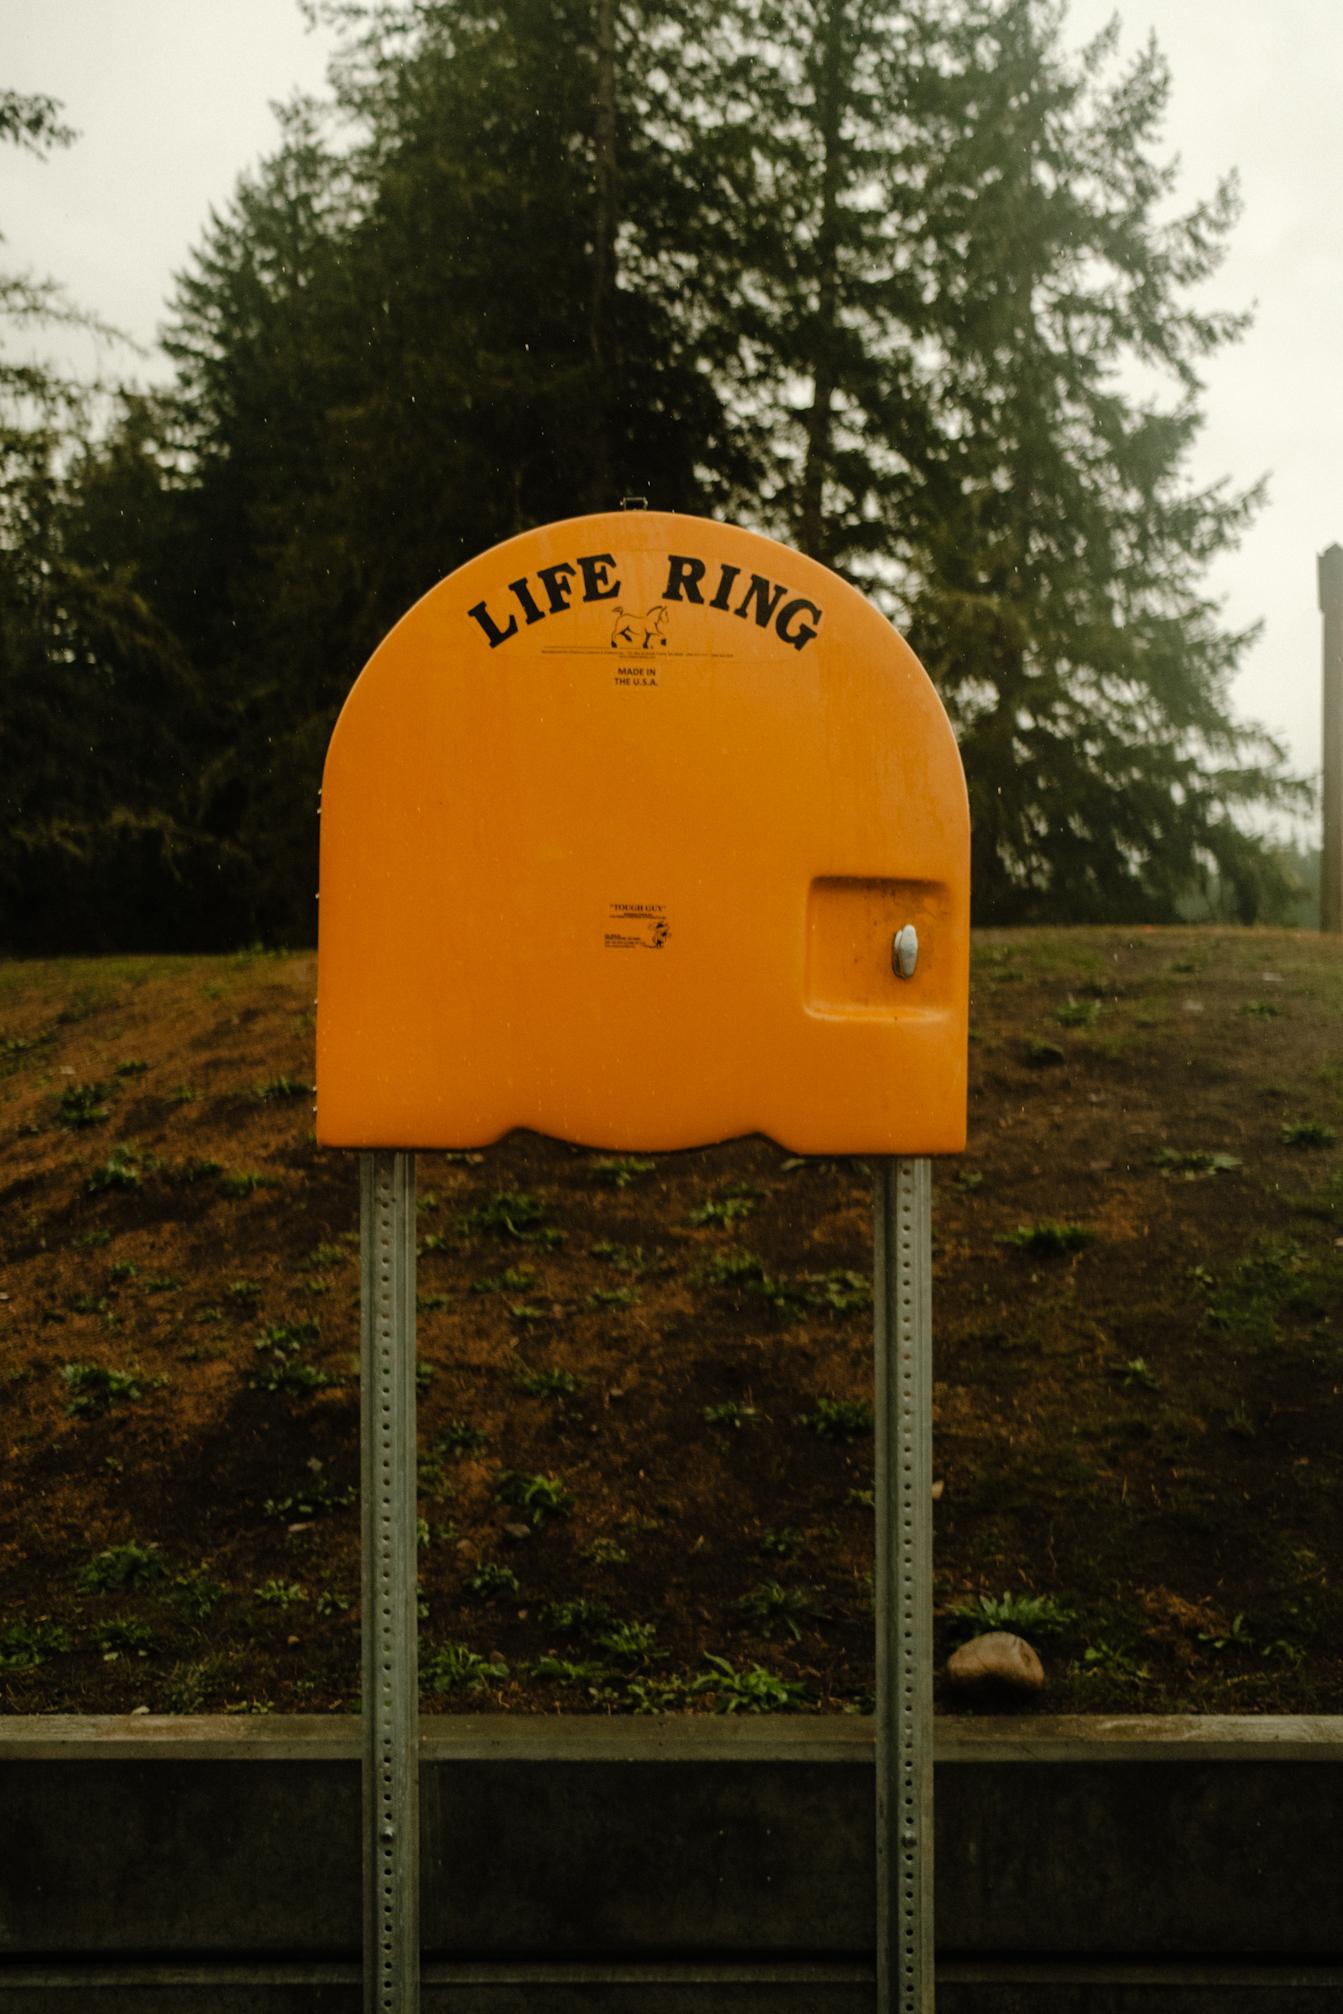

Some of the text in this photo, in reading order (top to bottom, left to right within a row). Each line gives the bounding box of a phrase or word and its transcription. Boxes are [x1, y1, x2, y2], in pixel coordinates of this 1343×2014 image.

[468, 553, 823, 650] LIFE RING
[617, 667, 656, 676] MADE IN
[614, 677, 658, 687] THE U.S.A.
